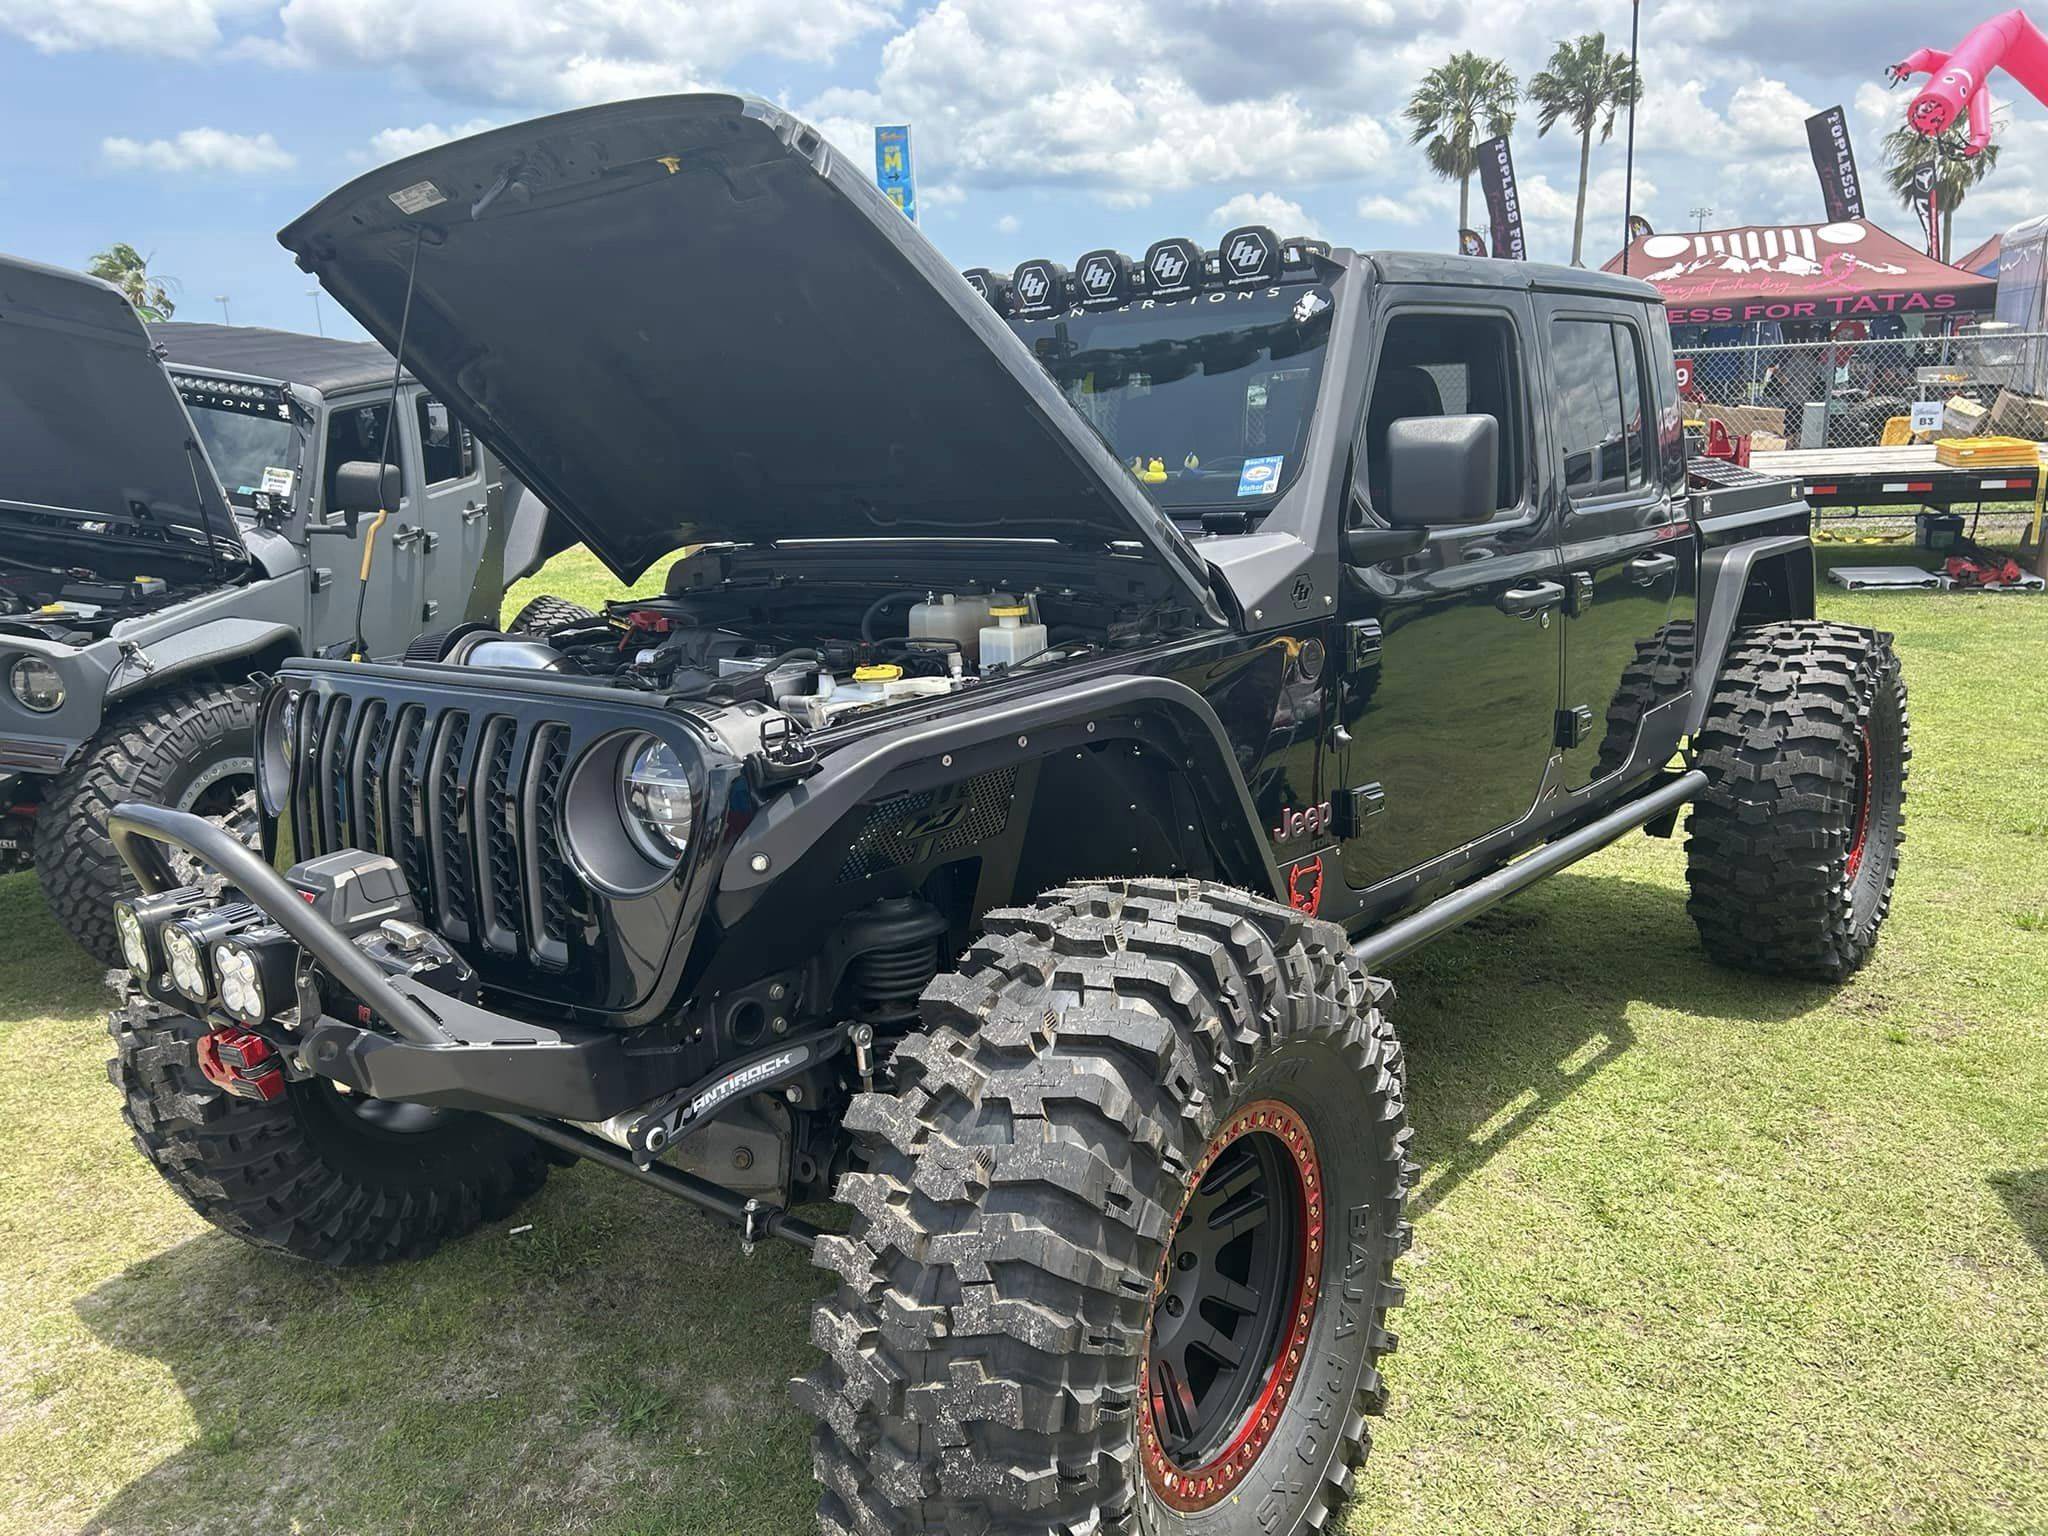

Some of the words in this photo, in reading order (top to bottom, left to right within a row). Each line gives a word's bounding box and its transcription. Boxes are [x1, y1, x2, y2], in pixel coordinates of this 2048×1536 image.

[1495, 139, 1519, 224] TOPLESS
[1828, 111, 1857, 199] TOPLESS
[1744, 302, 1816, 321] FOR
[1826, 292, 1957, 314] TATAS
[1919, 417, 1935, 426] B3
[1273, 801, 1332, 843] Jeep
[693, 1052, 793, 1113] ANTIROCK
[1335, 1203, 1371, 1341] BAJA
[1295, 1350, 1350, 1465] PRO
